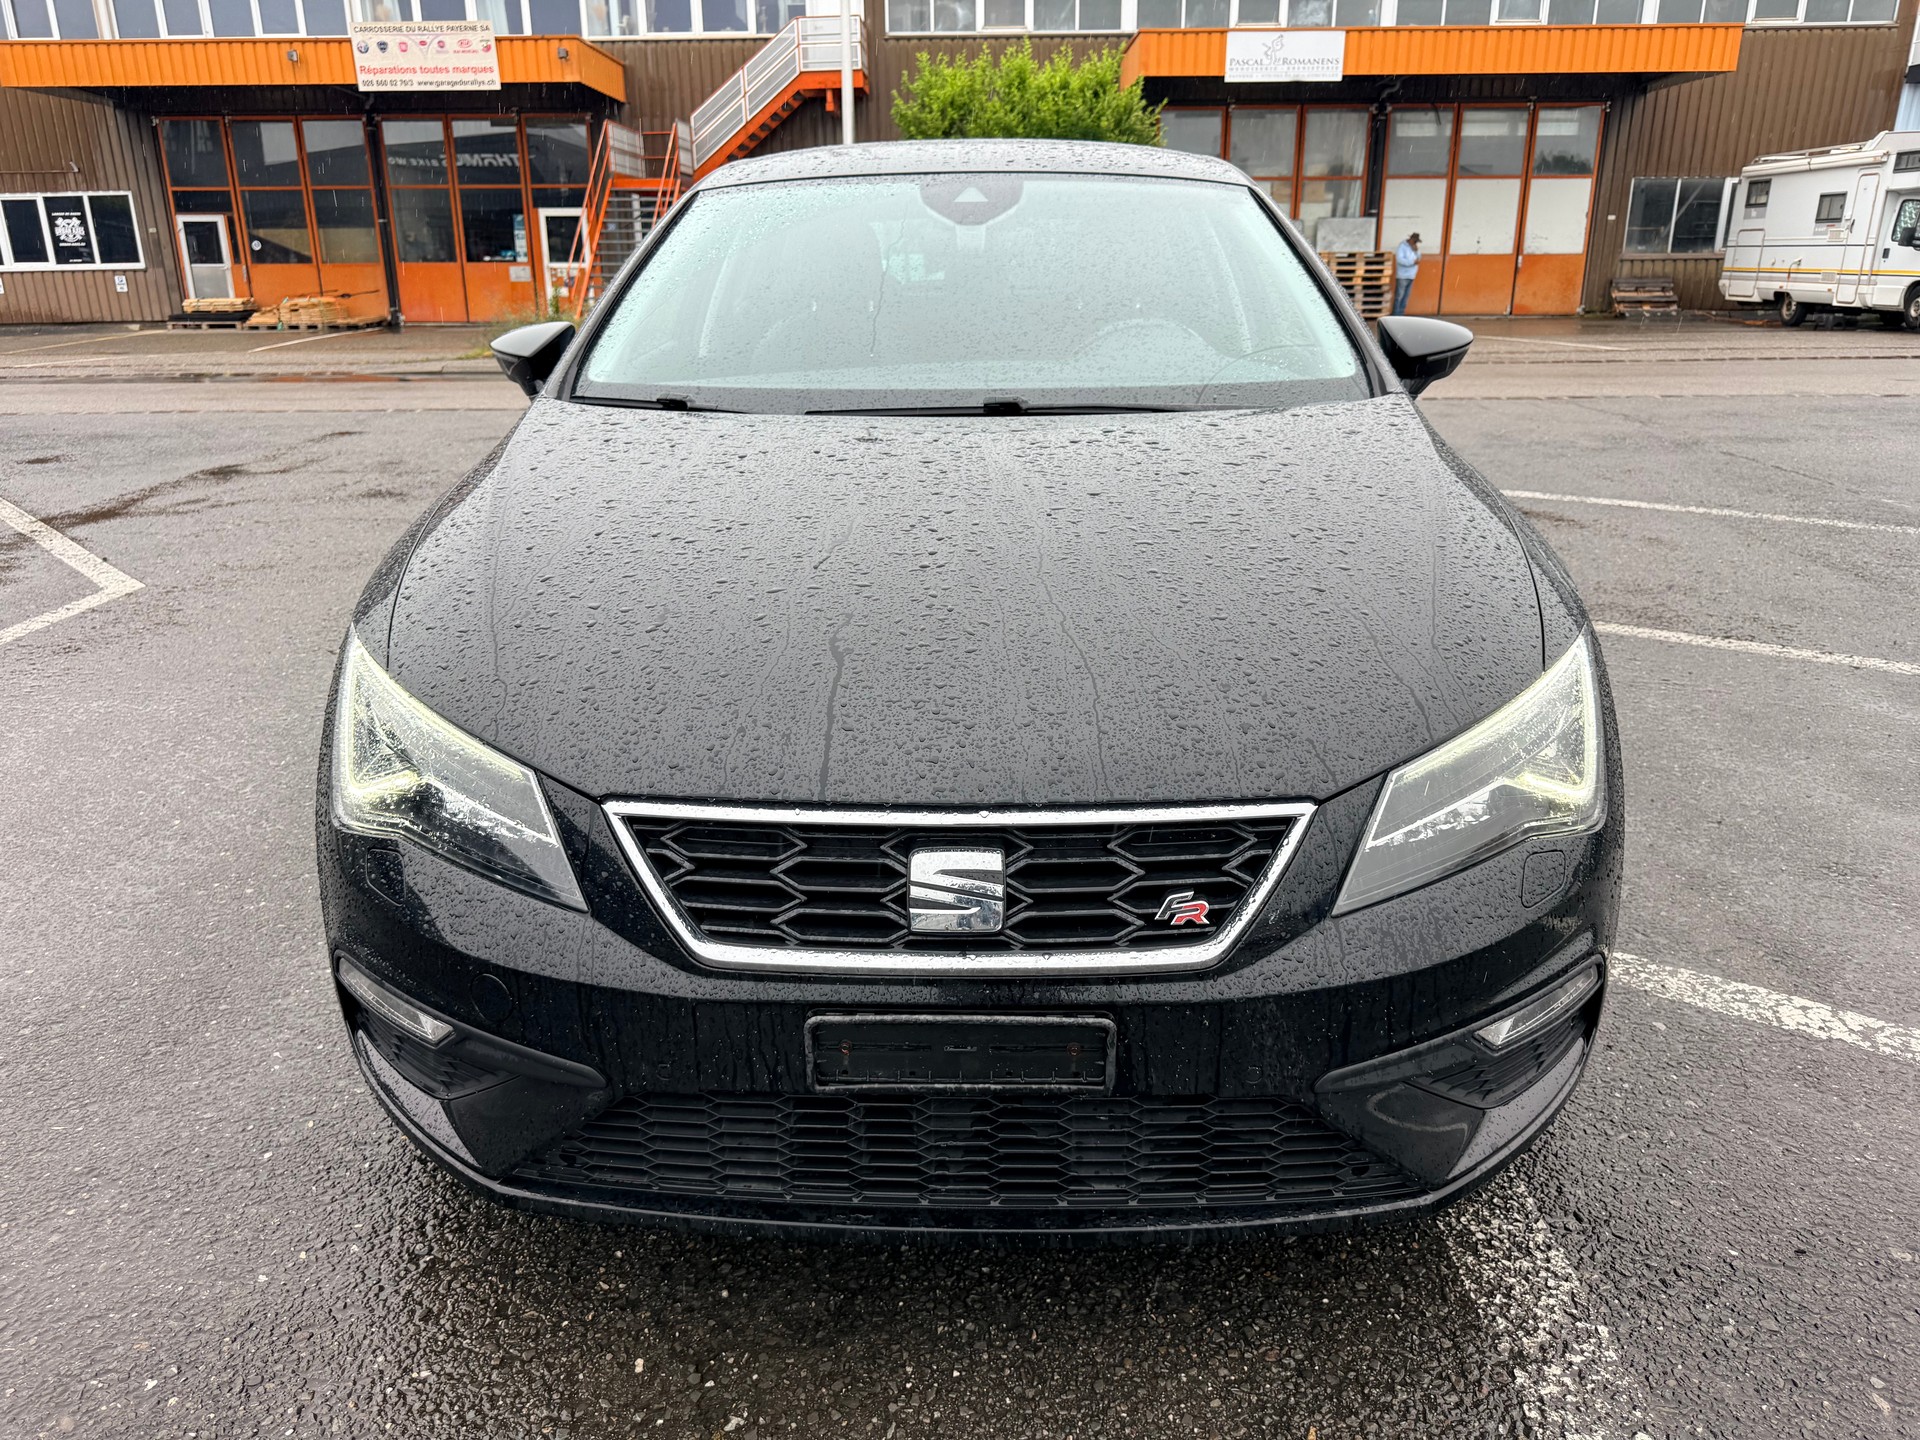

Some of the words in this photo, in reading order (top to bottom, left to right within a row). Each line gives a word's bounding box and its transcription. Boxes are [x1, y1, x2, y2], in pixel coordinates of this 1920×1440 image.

[353, 25, 404, 33] CARROSSERIE
[405, 25, 416, 33] DU
[417, 25, 445, 33] RALLYE
[446, 24, 478, 32] PAYERNE
[480, 24, 490, 32] SA
[1282, 57, 1340, 66] ROMANENS
[359, 64, 417, 76] Réparations
[419, 65, 450, 74] toutes
[452, 65, 495, 76] marques
[1154, 891, 1210, 926] FR
